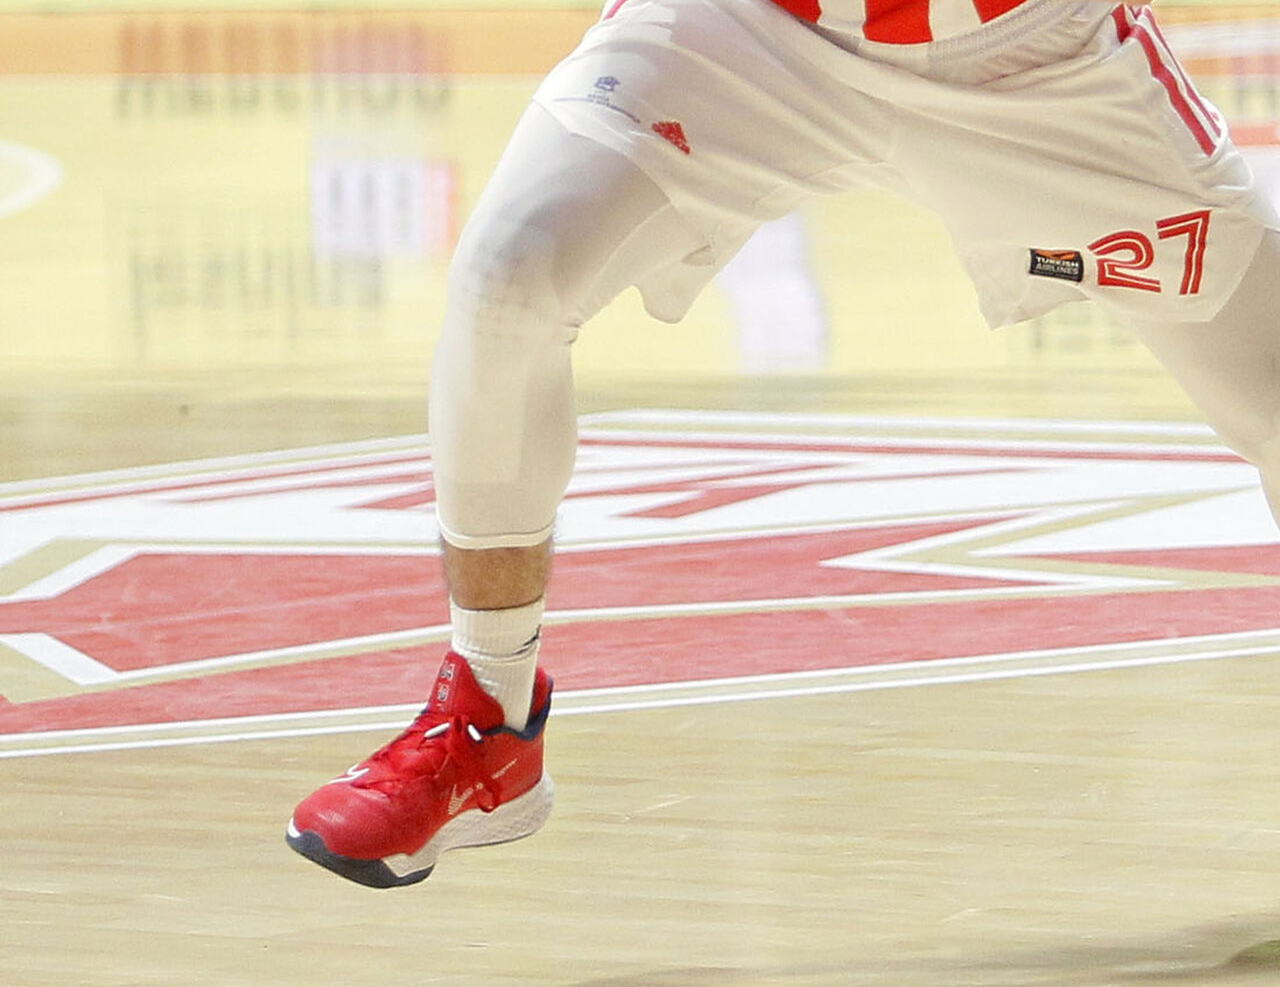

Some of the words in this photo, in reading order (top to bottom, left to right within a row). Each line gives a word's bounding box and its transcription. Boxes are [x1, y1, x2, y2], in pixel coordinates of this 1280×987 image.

[1087, 209, 1212, 295] 27
[1035, 256, 1079, 268] TURKISH
[1035, 263, 1079, 275] AIRLINES
